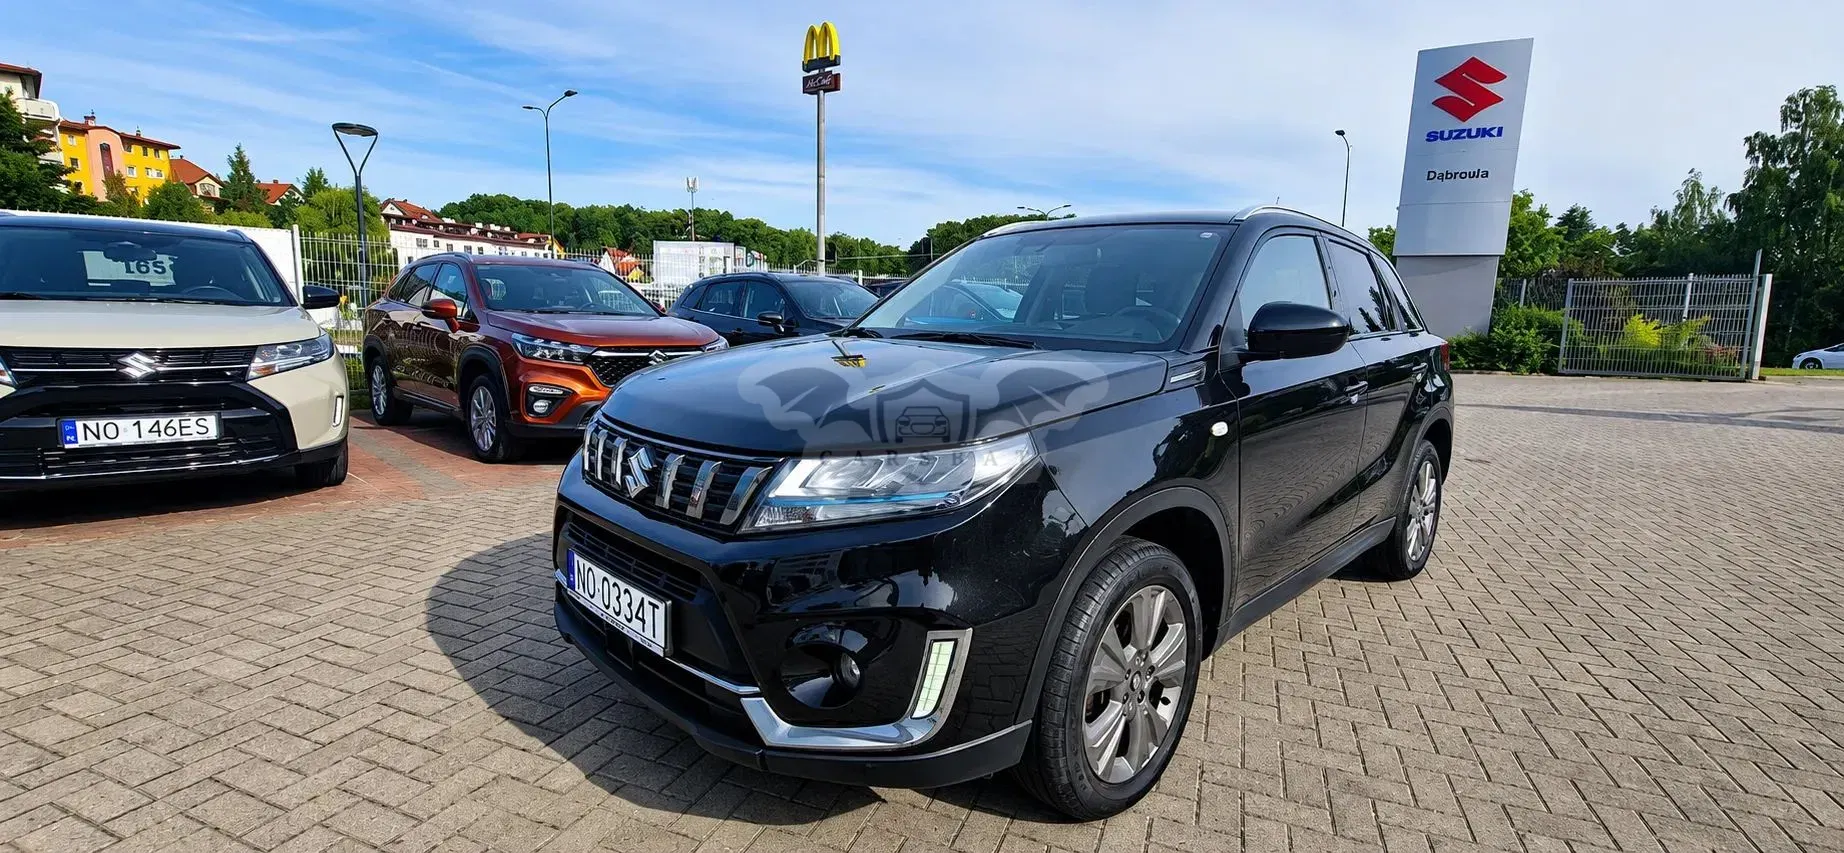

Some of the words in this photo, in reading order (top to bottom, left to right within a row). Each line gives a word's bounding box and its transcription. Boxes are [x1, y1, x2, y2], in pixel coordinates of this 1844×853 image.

[1425, 126, 1504, 142] SUZUKI
[82, 421, 120, 441] NO
[132, 417, 210, 439] 146ES
[576, 559, 596, 599] NO
[601, 576, 660, 639] 0334T
